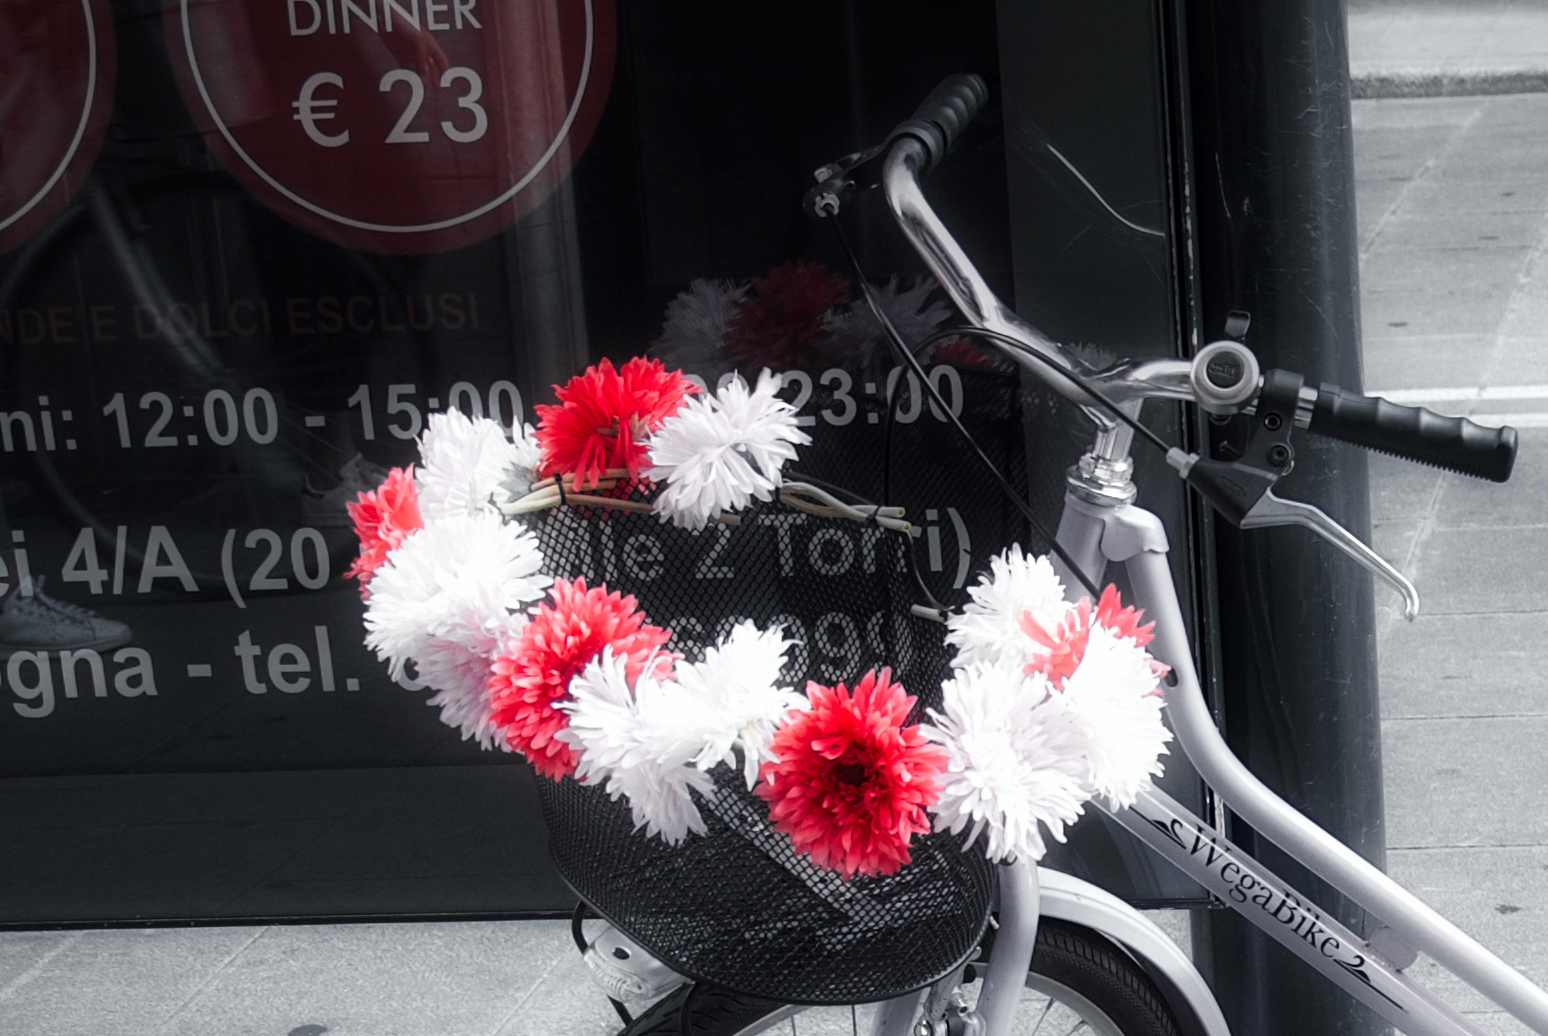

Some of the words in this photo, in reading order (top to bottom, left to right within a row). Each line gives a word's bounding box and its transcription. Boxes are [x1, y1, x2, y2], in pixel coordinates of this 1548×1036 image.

[286, 0, 483, 38] DINNER
[292, 71, 351, 148] €
[378, 65, 489, 145] 23
[134, 300, 272, 340] DOLCI
[287, 291, 481, 336] ESCLUSI
[102, 387, 279, 449] 12:00
[780, 364, 964, 427] 23:00
[61, 525, 201, 596] 4/A
[220, 528, 332, 609] (20
[0, 645, 159, 719] gna
[233, 625, 361, 695] tel.
[1188, 821, 1343, 959] WegaBike
